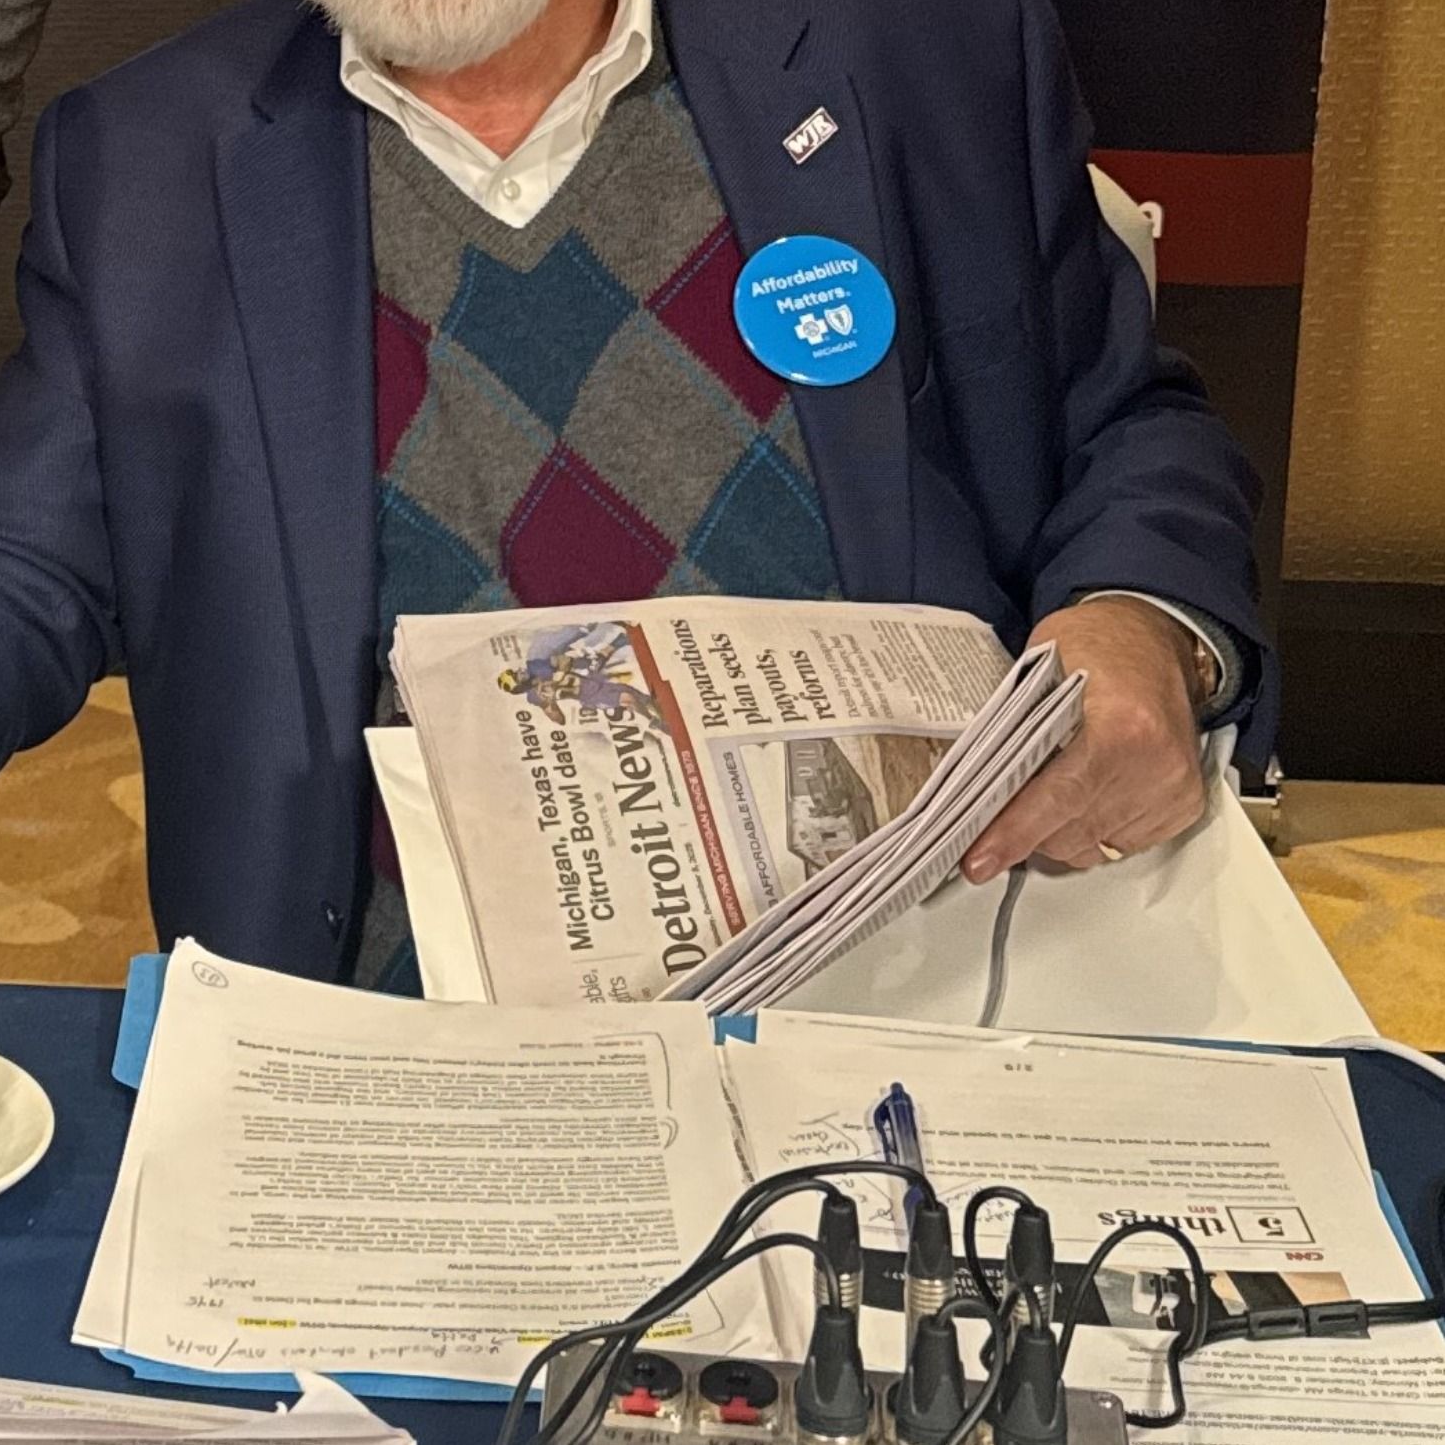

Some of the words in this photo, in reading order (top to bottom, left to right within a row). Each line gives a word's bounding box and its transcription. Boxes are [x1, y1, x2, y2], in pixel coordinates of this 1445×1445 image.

[787, 112, 833, 156] WJR
[751, 258, 859, 298] Affordability
[670, 619, 729, 729] Reparations
[707, 633, 746, 680] seeks
[756, 649, 808, 723] payouts,
[789, 650, 836, 720] reforms
[732, 683, 772, 725] plan
[515, 710, 544, 761] have
[550, 729, 577, 778] date
[604, 705, 664, 817] News
[532, 766, 562, 832] Texas
[723, 752, 744, 802] HOMES
[558, 783, 594, 844] Bowl
[737, 804, 774, 895] AFFORDABLE
[552, 835, 594, 951] Michigan,
[582, 847, 615, 921] Citrus
[630, 820, 708, 977] Detroit
[1256, 1217, 1283, 1234] 5
[1284, 1251, 1323, 1261] CNN
